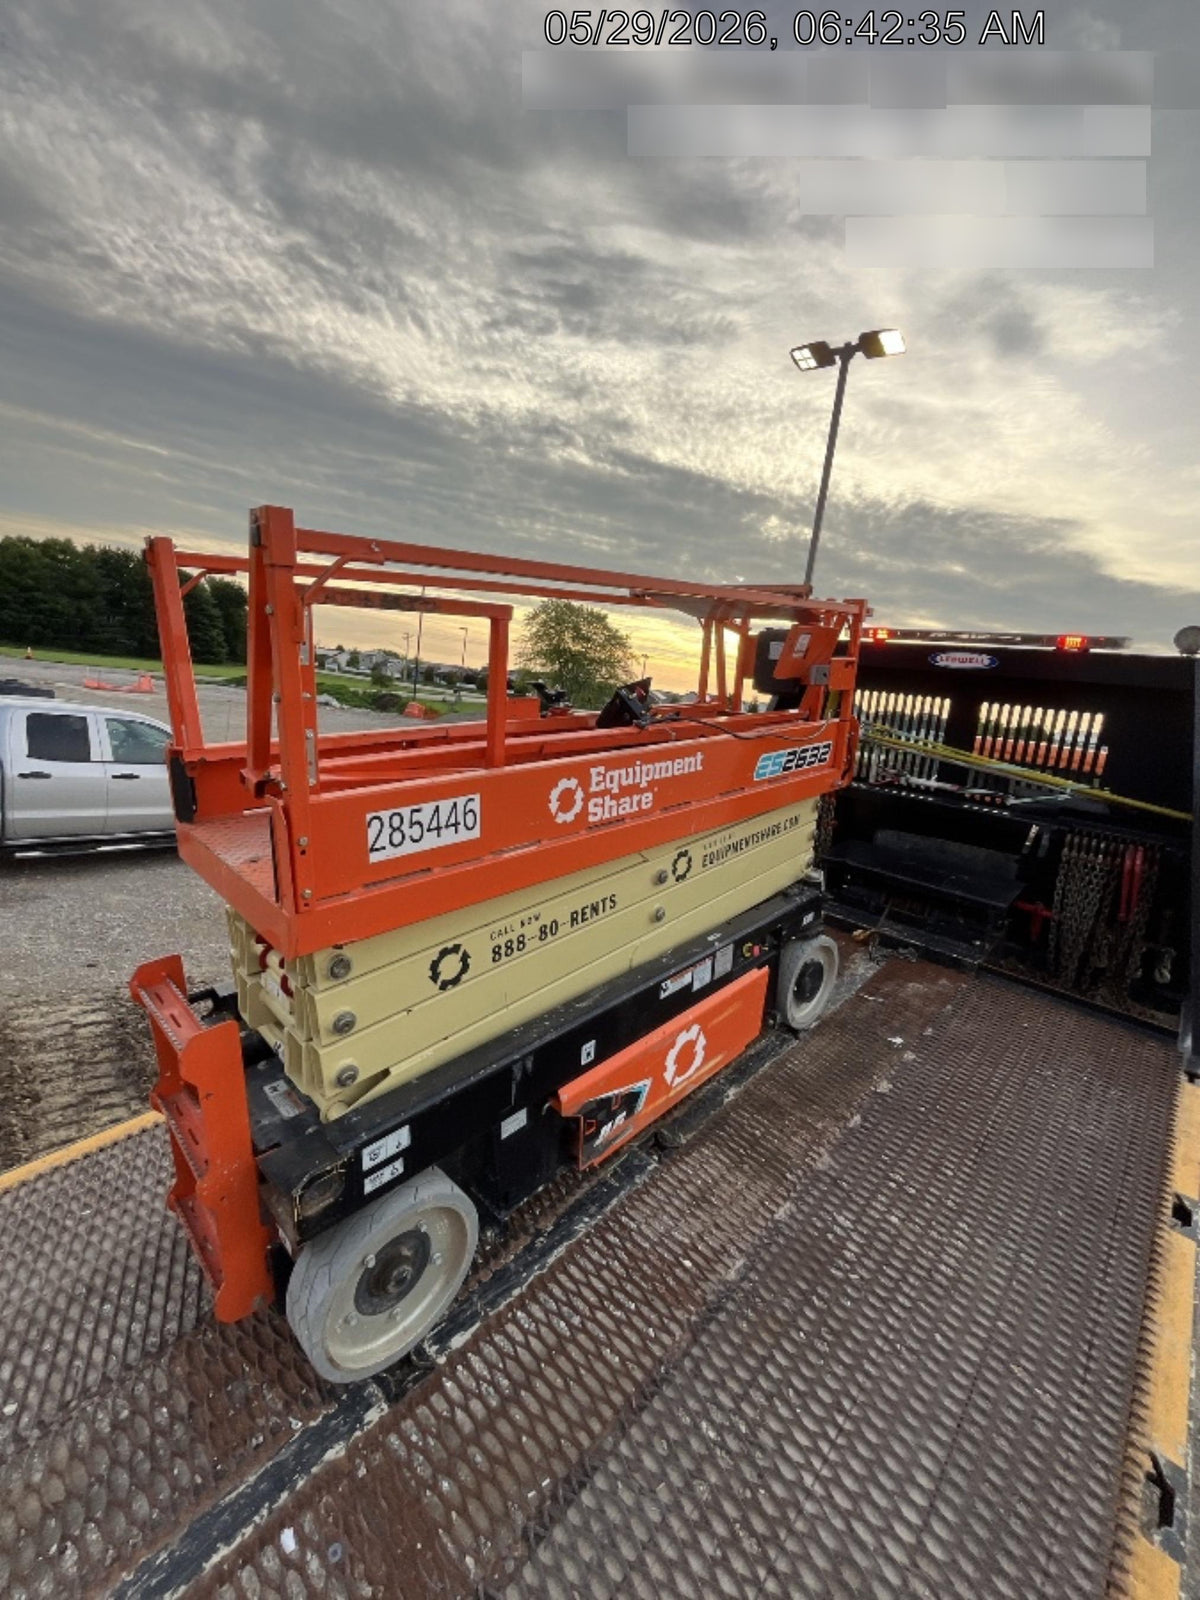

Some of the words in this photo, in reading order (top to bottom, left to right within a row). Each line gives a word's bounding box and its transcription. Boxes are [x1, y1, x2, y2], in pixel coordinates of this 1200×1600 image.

[590, 751, 704, 793] Equipment
[755, 742, 831, 780] ES2632
[367, 798, 477, 853] 285446
[588, 791, 654, 822] Share
[491, 893, 617, 963] 888-80-RENTS
